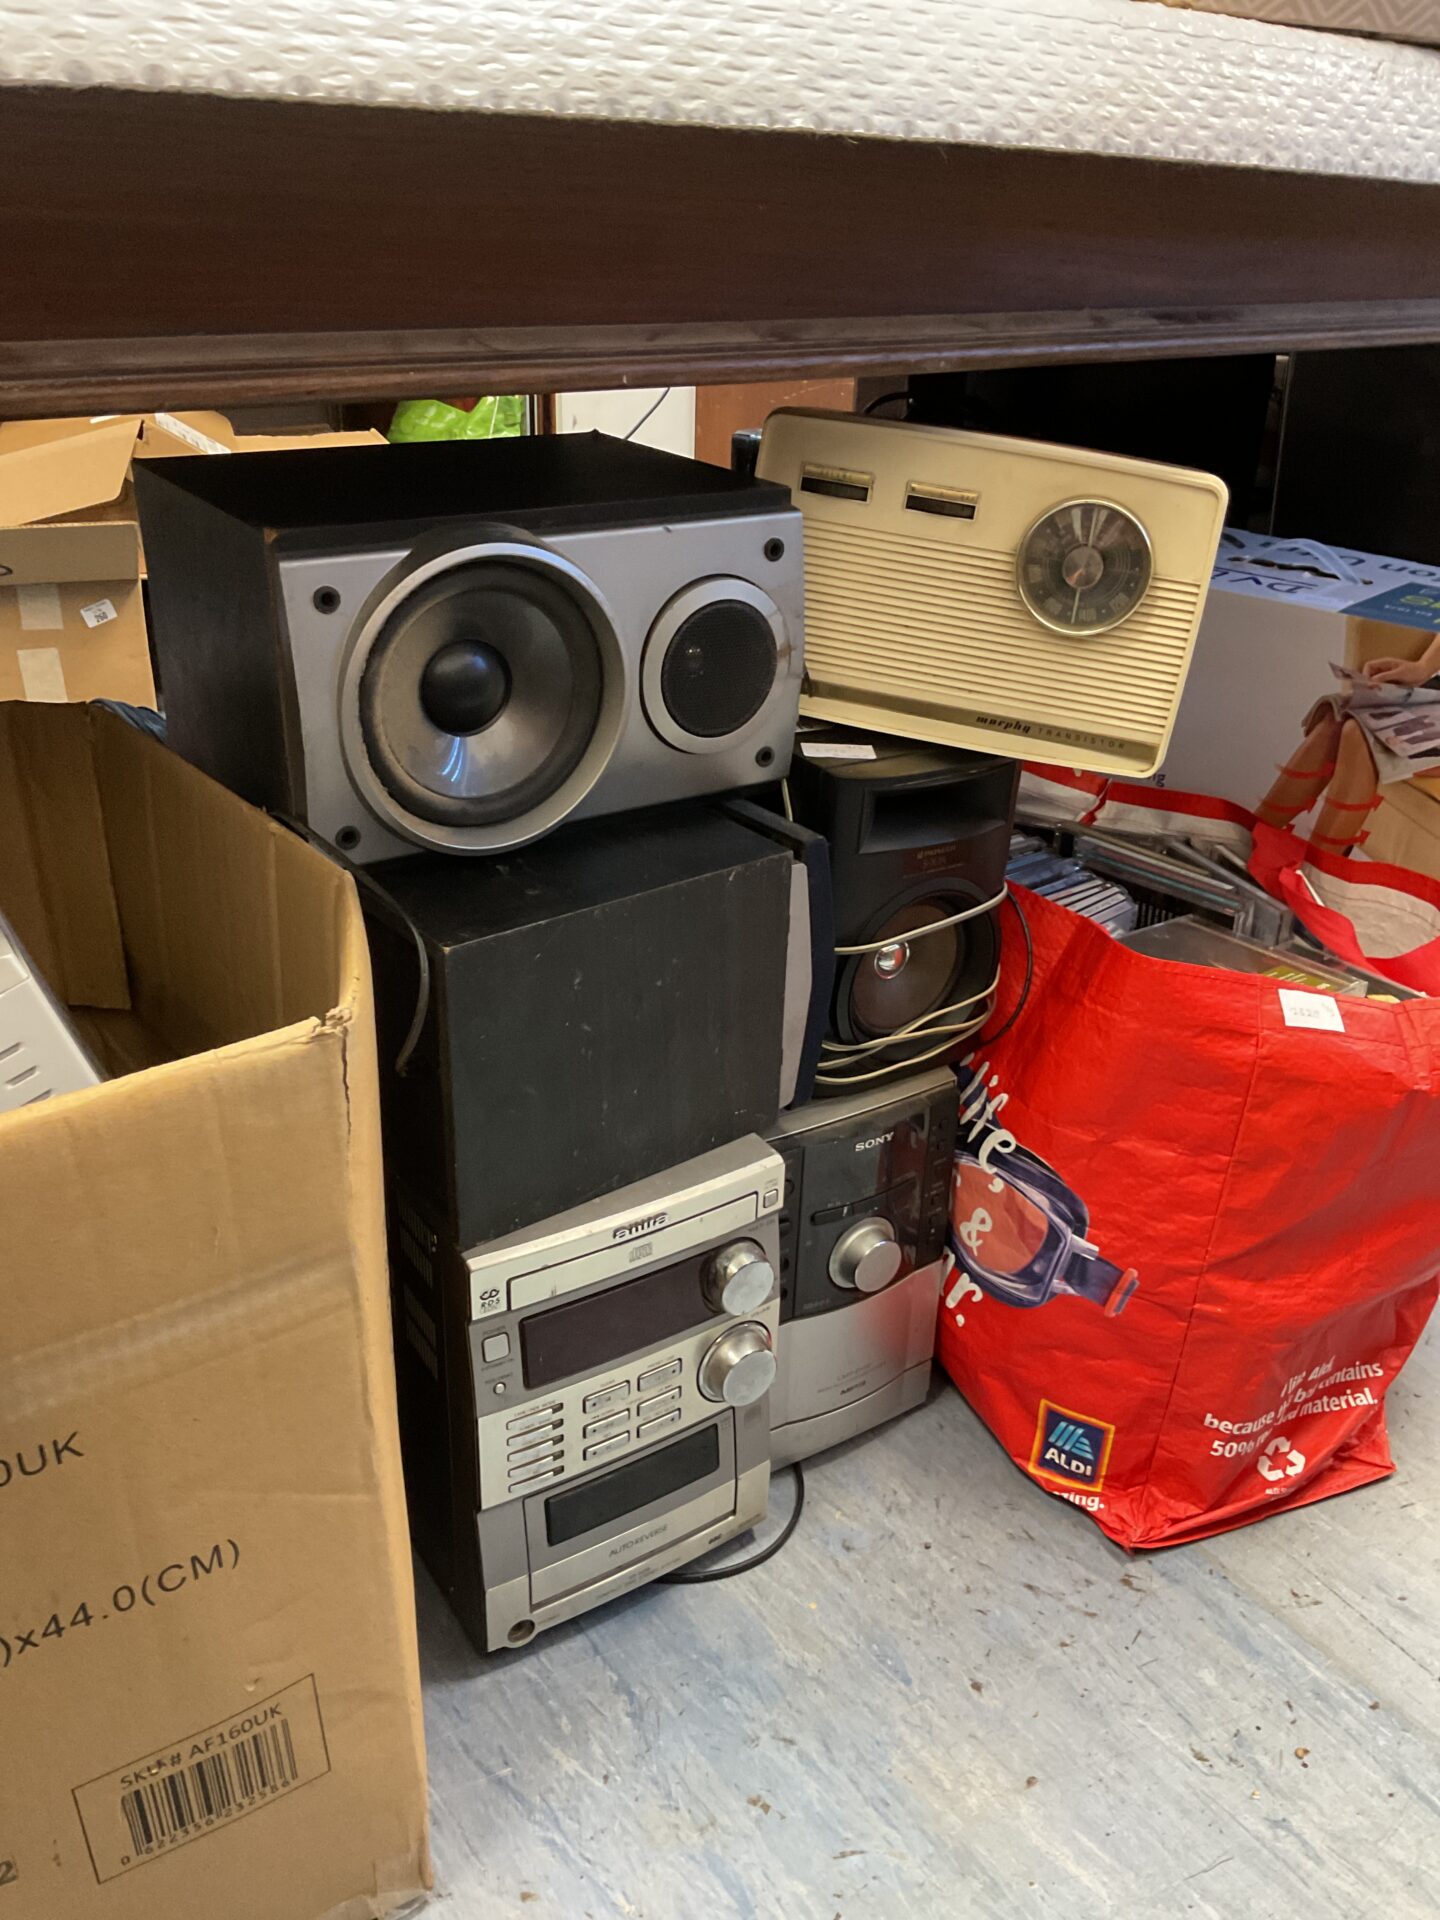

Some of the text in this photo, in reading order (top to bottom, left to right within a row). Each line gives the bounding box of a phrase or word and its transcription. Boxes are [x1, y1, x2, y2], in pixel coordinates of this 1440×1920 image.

[1038, 727, 1125, 749] TRANSISTOR
[855, 1131, 894, 1151] SONY
[959, 1207, 993, 1257] &
[1203, 1411, 1275, 1435] because
[1209, 1440, 1254, 1458] 50%
[1299, 1387, 1379, 1416] material.
[1044, 1447, 1092, 1476] ALDI
[189, 1703, 281, 1758] AF160UK
